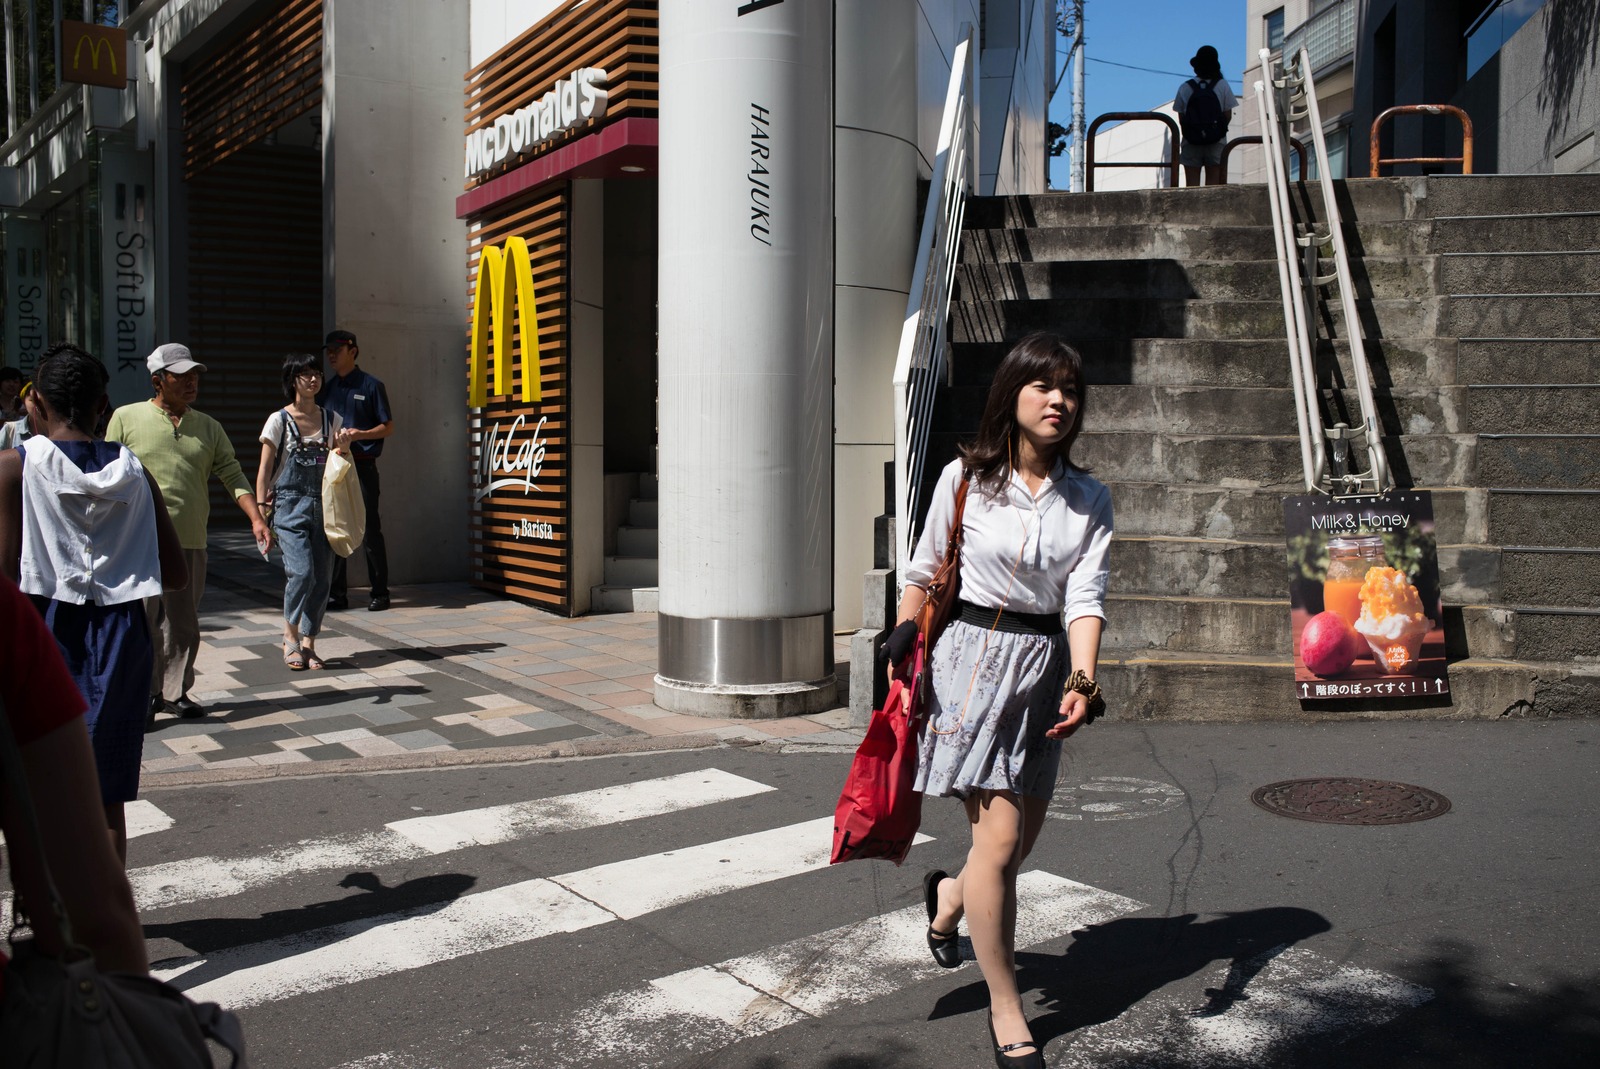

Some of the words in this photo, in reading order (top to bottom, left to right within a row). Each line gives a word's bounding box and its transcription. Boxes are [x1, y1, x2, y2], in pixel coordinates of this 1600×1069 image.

[464, 66, 608, 179] McDonald's
[747, 102, 772, 247] HARAJUKU
[116, 231, 145, 373] SoftBank
[476, 414, 548, 498] McCafé
[512, 523, 520, 539] by
[521, 518, 553, 540] Barista
[1311, 514, 1343, 530] Milk
[1345, 513, 1357, 528] &
[1358, 513, 1410, 528] Honey
